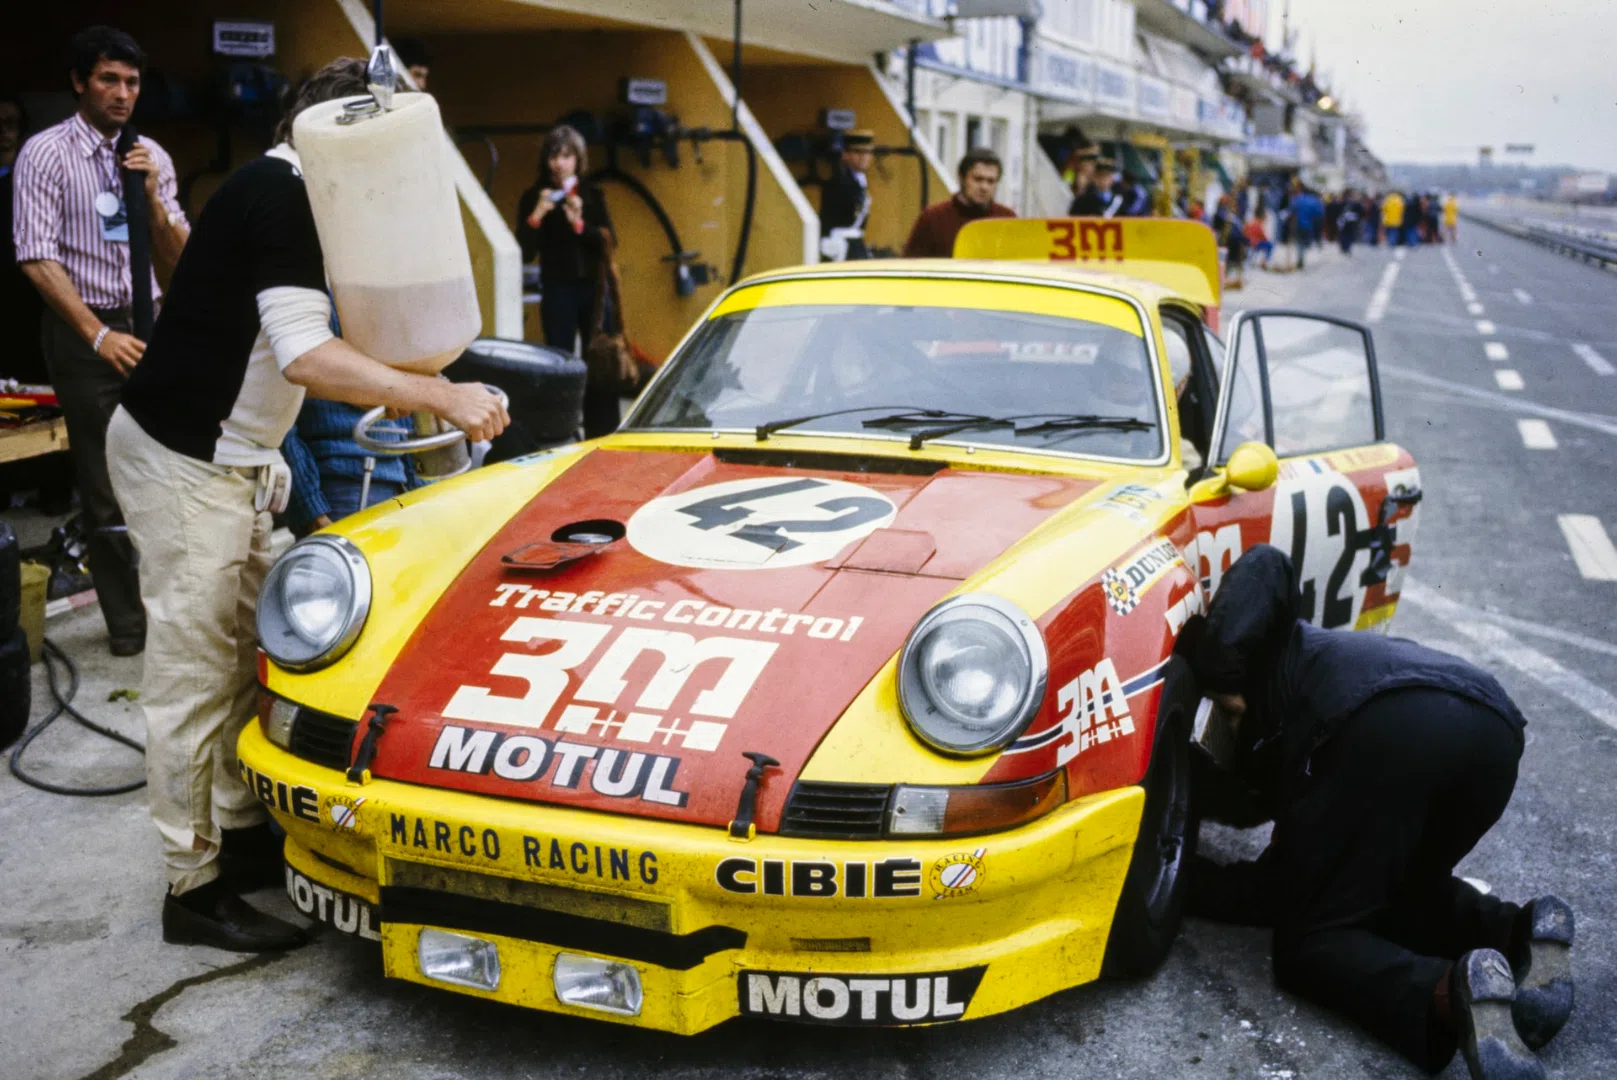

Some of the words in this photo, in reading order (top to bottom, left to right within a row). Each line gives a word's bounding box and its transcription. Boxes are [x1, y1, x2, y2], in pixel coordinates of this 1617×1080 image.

[675, 478, 896, 553] 42
[489, 583, 664, 621] Traffic
[663, 599, 864, 642] Control
[441, 615, 780, 751] 3M
[427, 725, 689, 807] MOTUL
[390, 812, 501, 861] MARCO
[523, 836, 659, 885] RACING
[935, 854, 981, 872] RACING
[748, 973, 965, 1021] MOTUL
